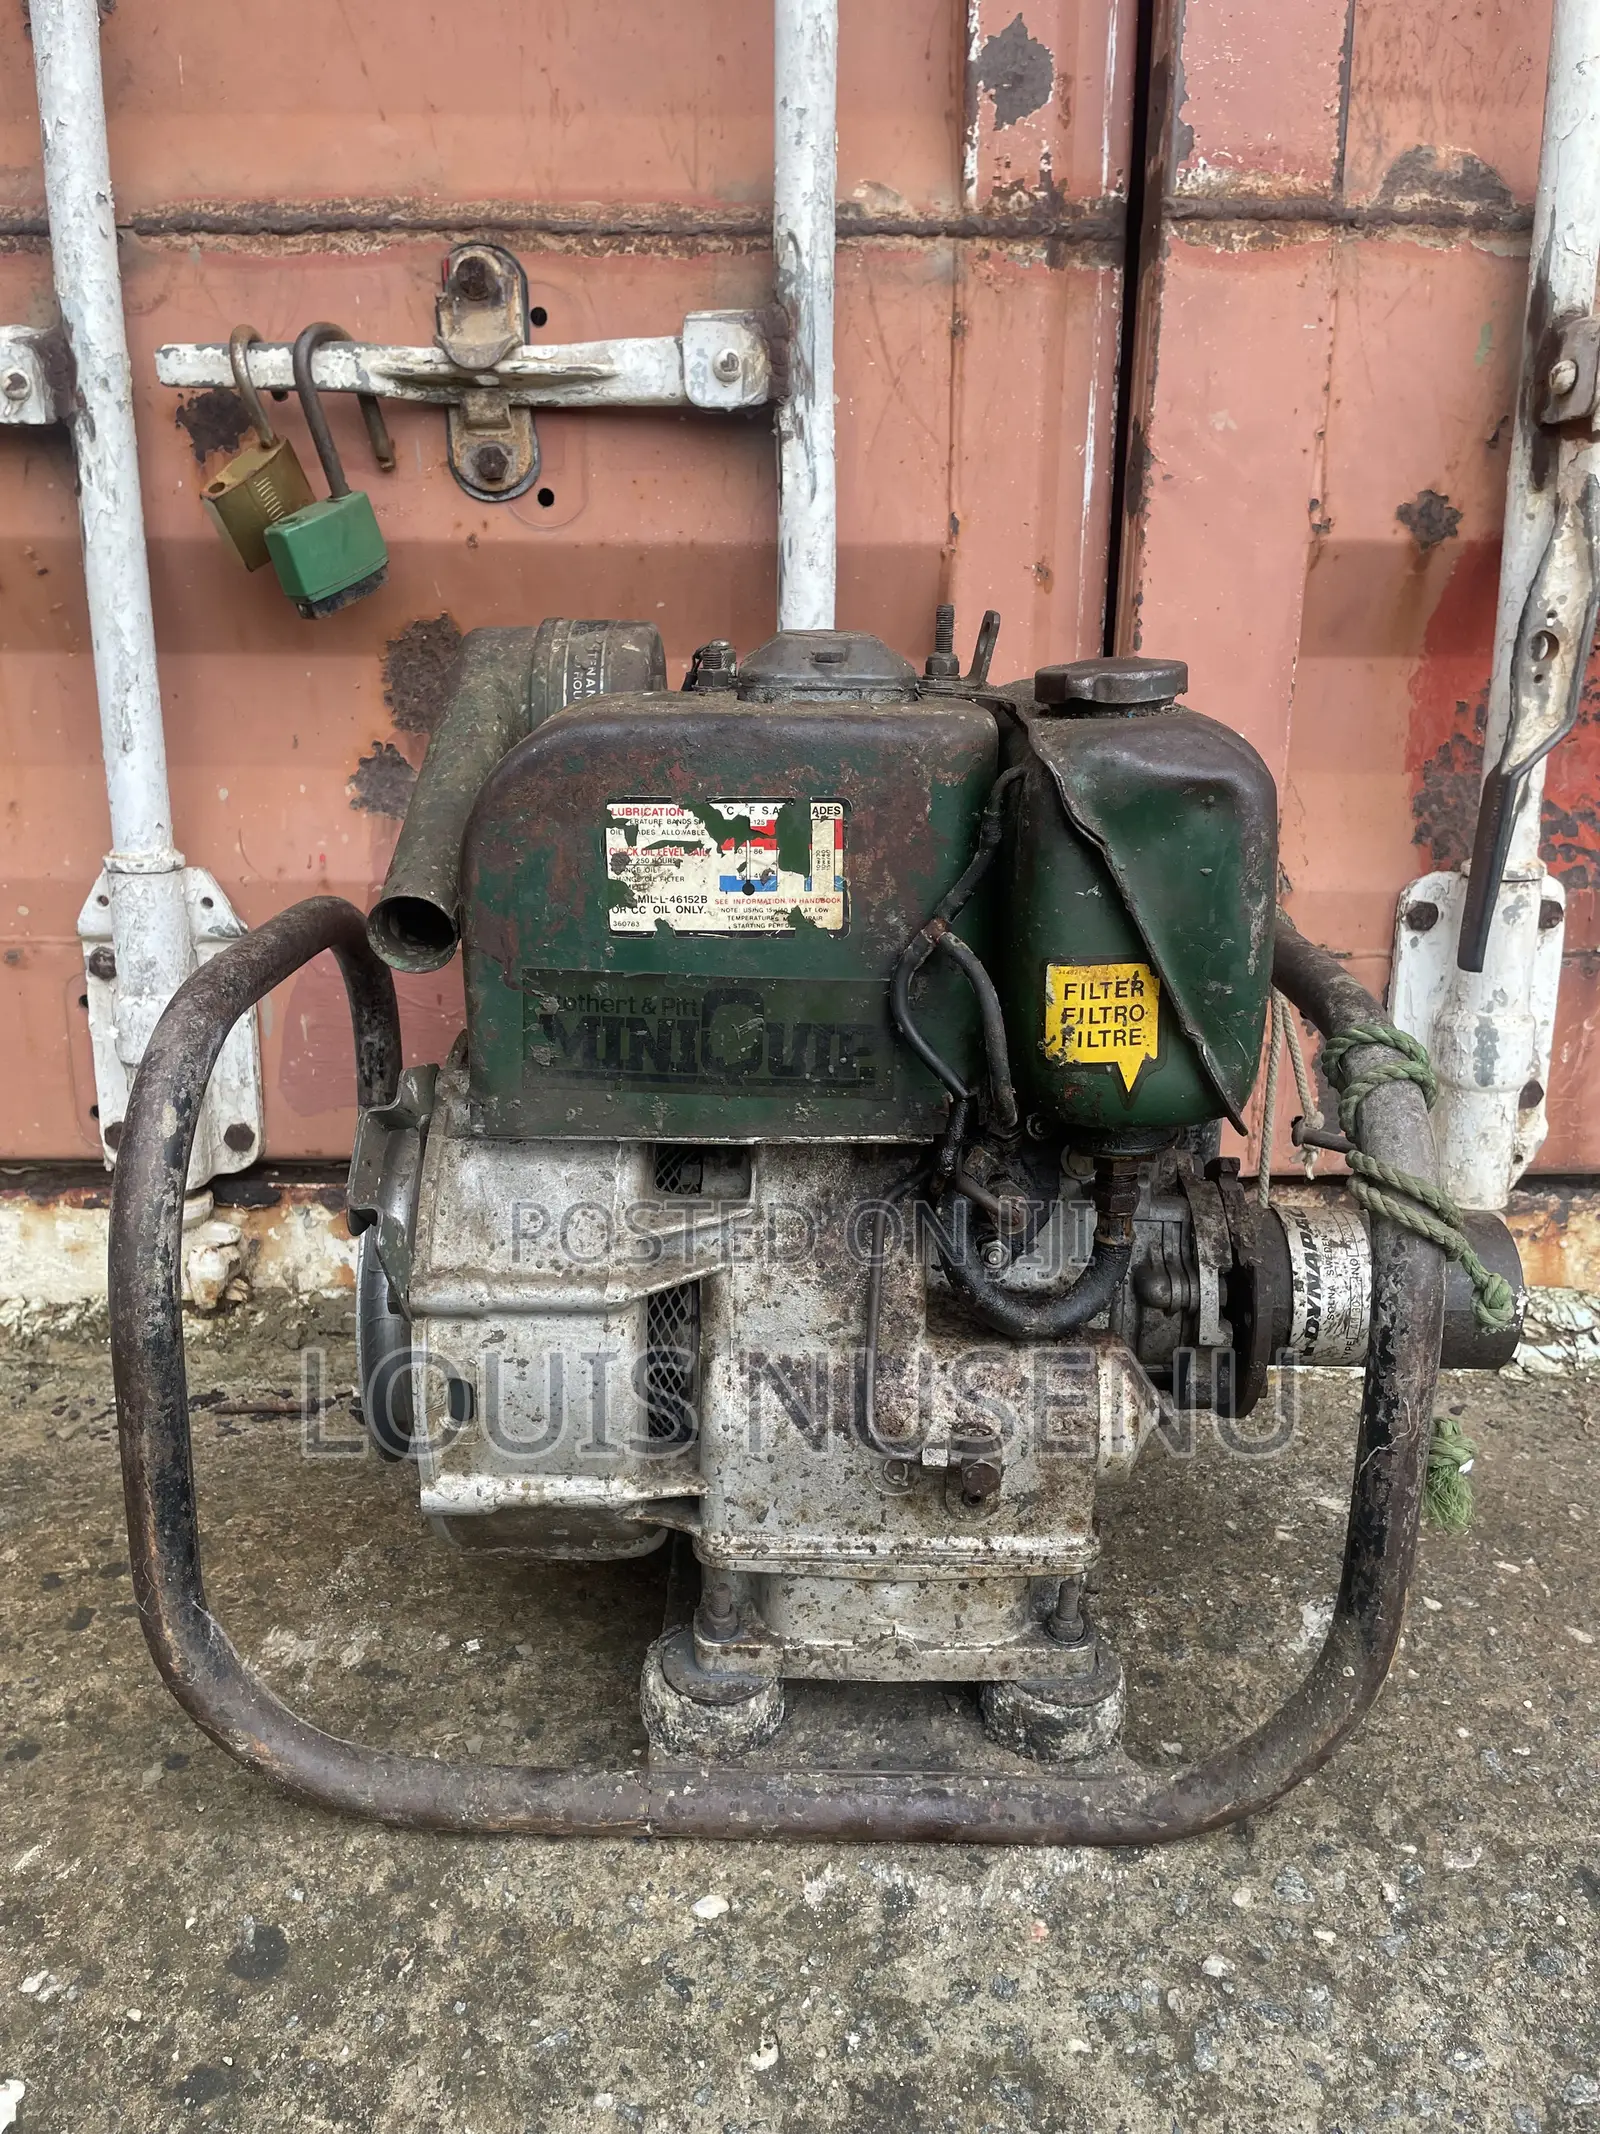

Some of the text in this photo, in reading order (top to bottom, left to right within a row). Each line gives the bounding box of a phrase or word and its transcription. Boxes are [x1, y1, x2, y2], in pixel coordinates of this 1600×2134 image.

[611, 807, 684, 817] LUBRICATION
[641, 847, 655, 856] OIL
[656, 847, 684, 857] LEVEL
[637, 895, 708, 904] MIL-L-46152B
[612, 906, 707, 914] OR CC OIL ONLY.
[1063, 979, 1145, 1001] FILTER
[1061, 1003, 1145, 1025] FILTRO
[1061, 1027, 1142, 1048] FILTRE
[1322, 1235, 1337, 1321] SOLNA SWEDEN
